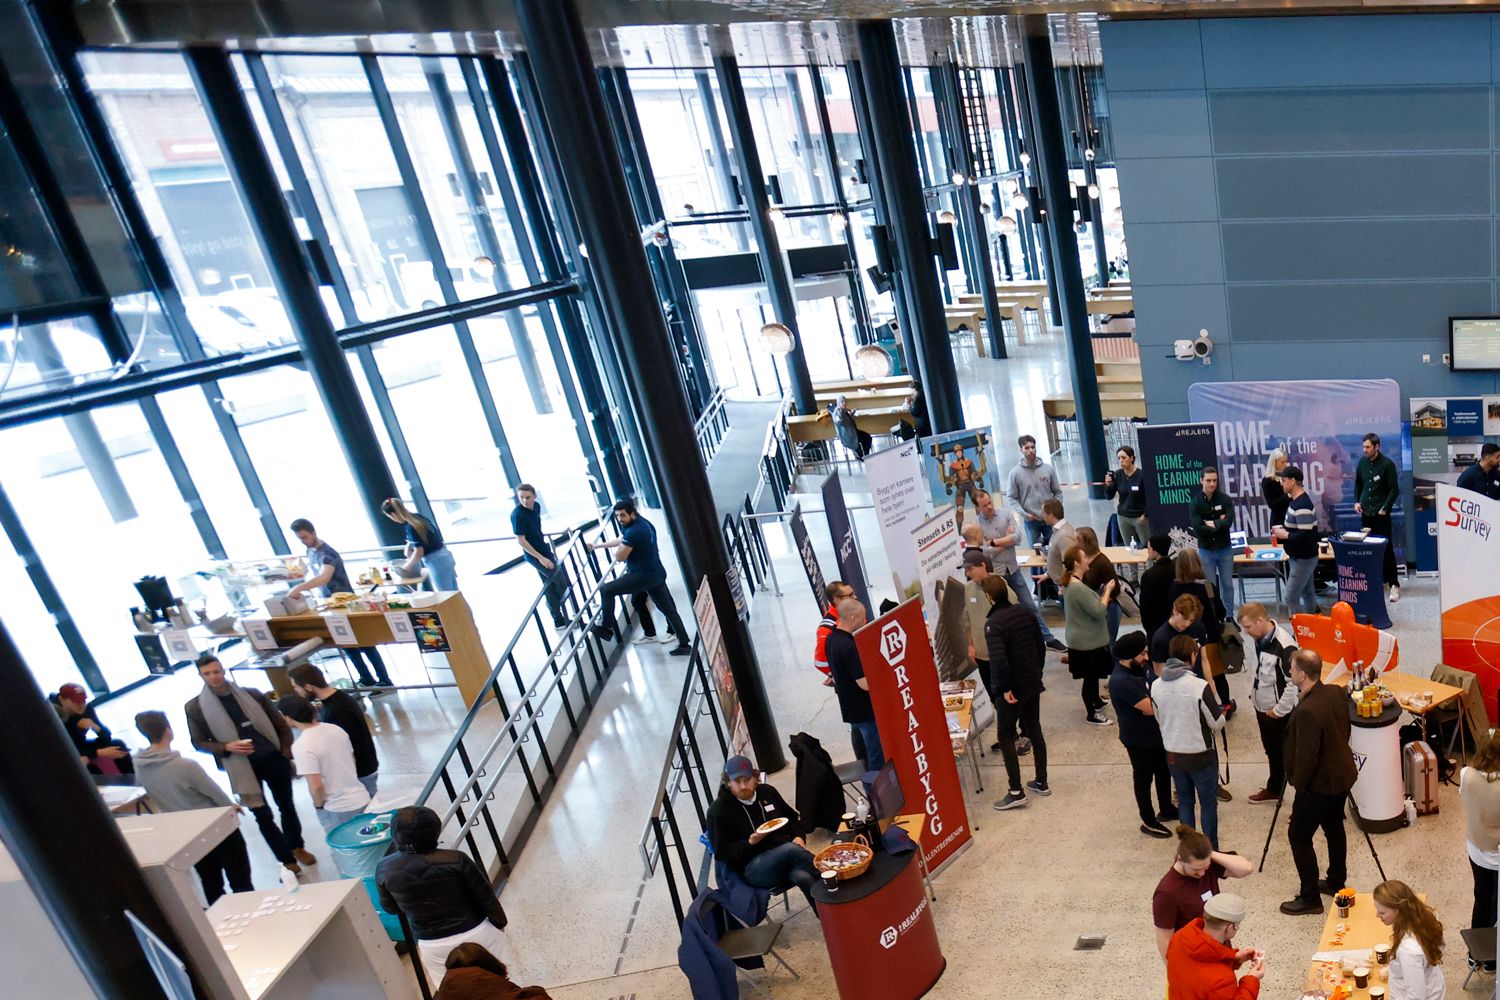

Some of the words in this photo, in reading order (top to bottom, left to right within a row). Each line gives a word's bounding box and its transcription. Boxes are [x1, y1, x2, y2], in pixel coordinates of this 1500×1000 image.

[1179, 428, 1210, 436] REJLERS
[1214, 420, 1271, 456] OME
[1297, 436, 1318, 454] the
[901, 450, 911, 458] NCC
[1155, 454, 1184, 469] HOME
[1186, 460, 1194, 468] of
[1157, 471, 1201, 487] LEARNIN
[876, 486, 890, 496] Bygg
[905, 486, 915, 494] over
[1160, 489, 1191, 504] MINDS
[917, 528, 940, 547] Stenseth
[946, 519, 953, 529] RS
[840, 541, 852, 564] NCC
[1338, 564, 1354, 578] HOME
[1339, 577, 1368, 591] LEARNING
[894, 664, 943, 837] REALBYGG
